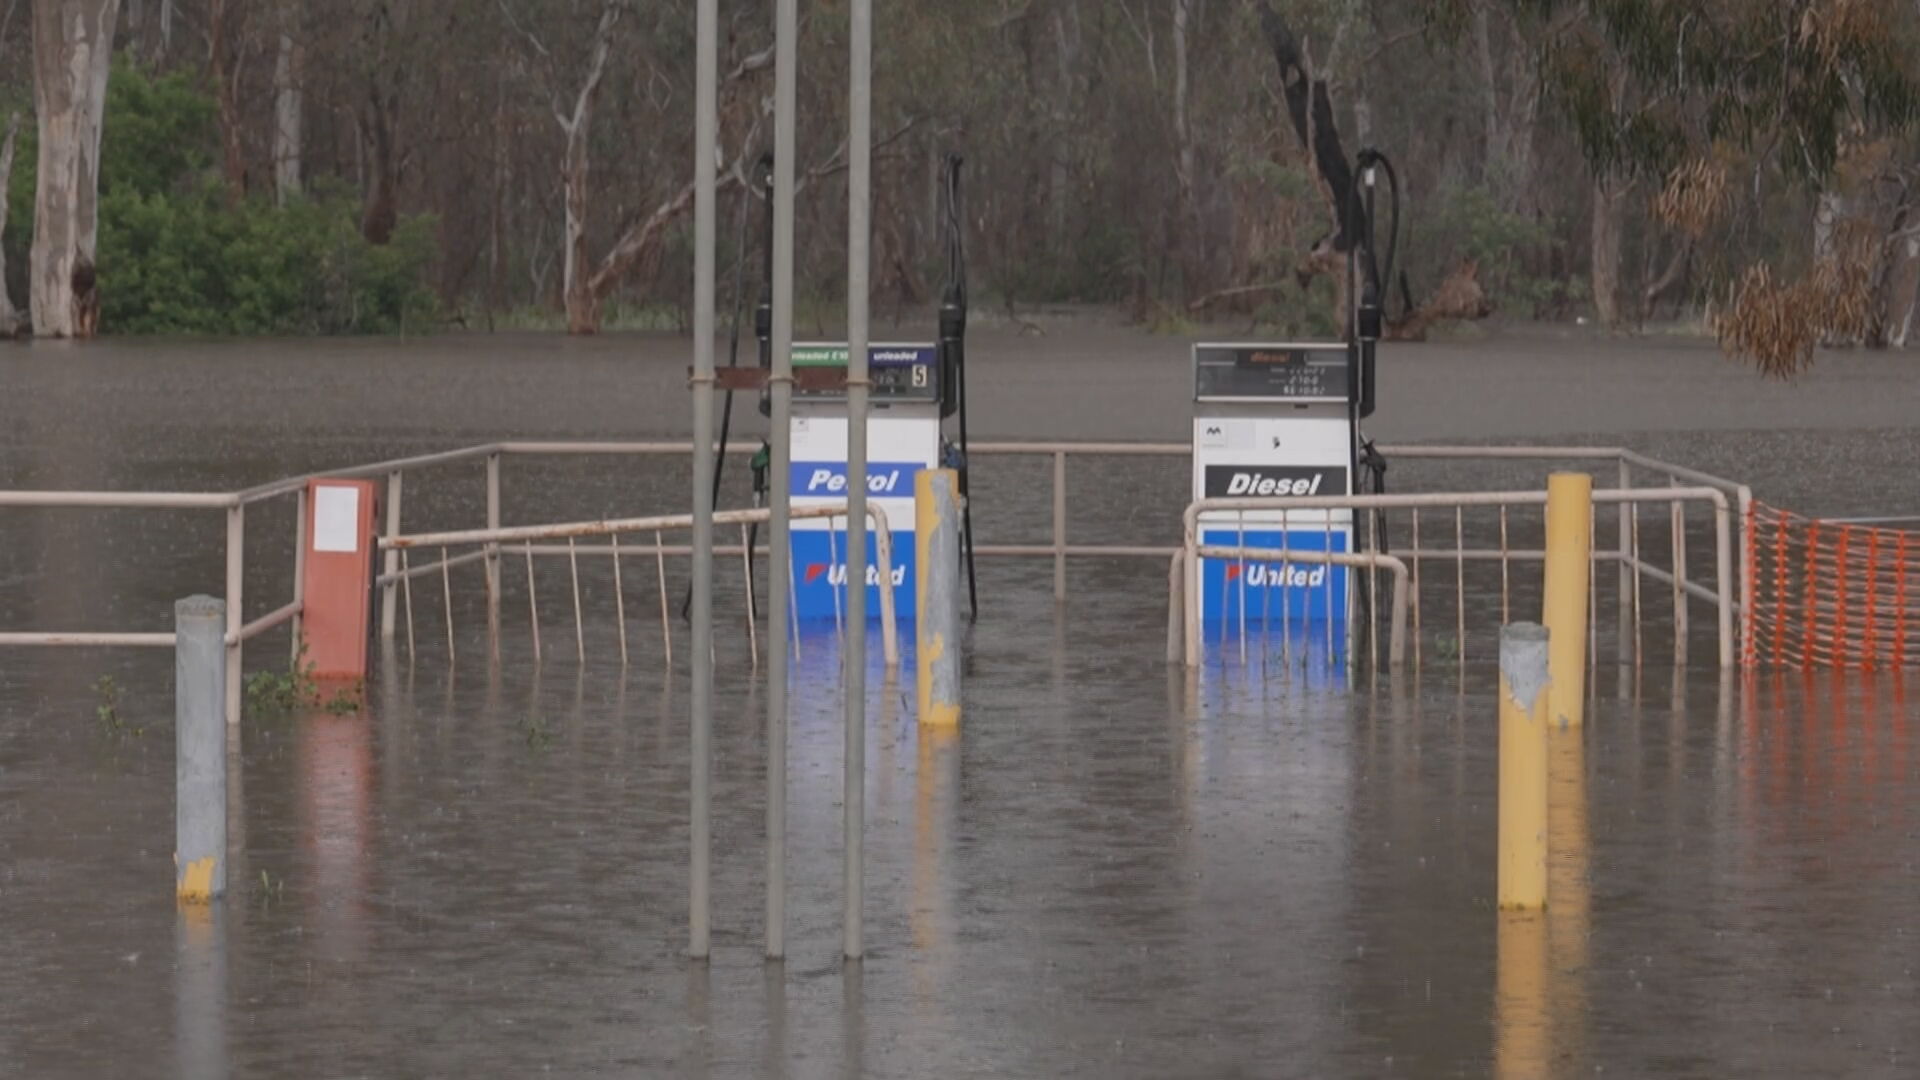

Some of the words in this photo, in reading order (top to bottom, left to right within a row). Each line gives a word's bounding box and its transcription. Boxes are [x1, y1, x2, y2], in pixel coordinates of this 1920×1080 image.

[792, 351, 829, 361] nleaded
[873, 351, 917, 361] unleaded
[914, 366, 925, 385] 5
[808, 469, 899, 491] Peol
[1226, 472, 1322, 496] Diesel
[1247, 564, 1325, 587] United
